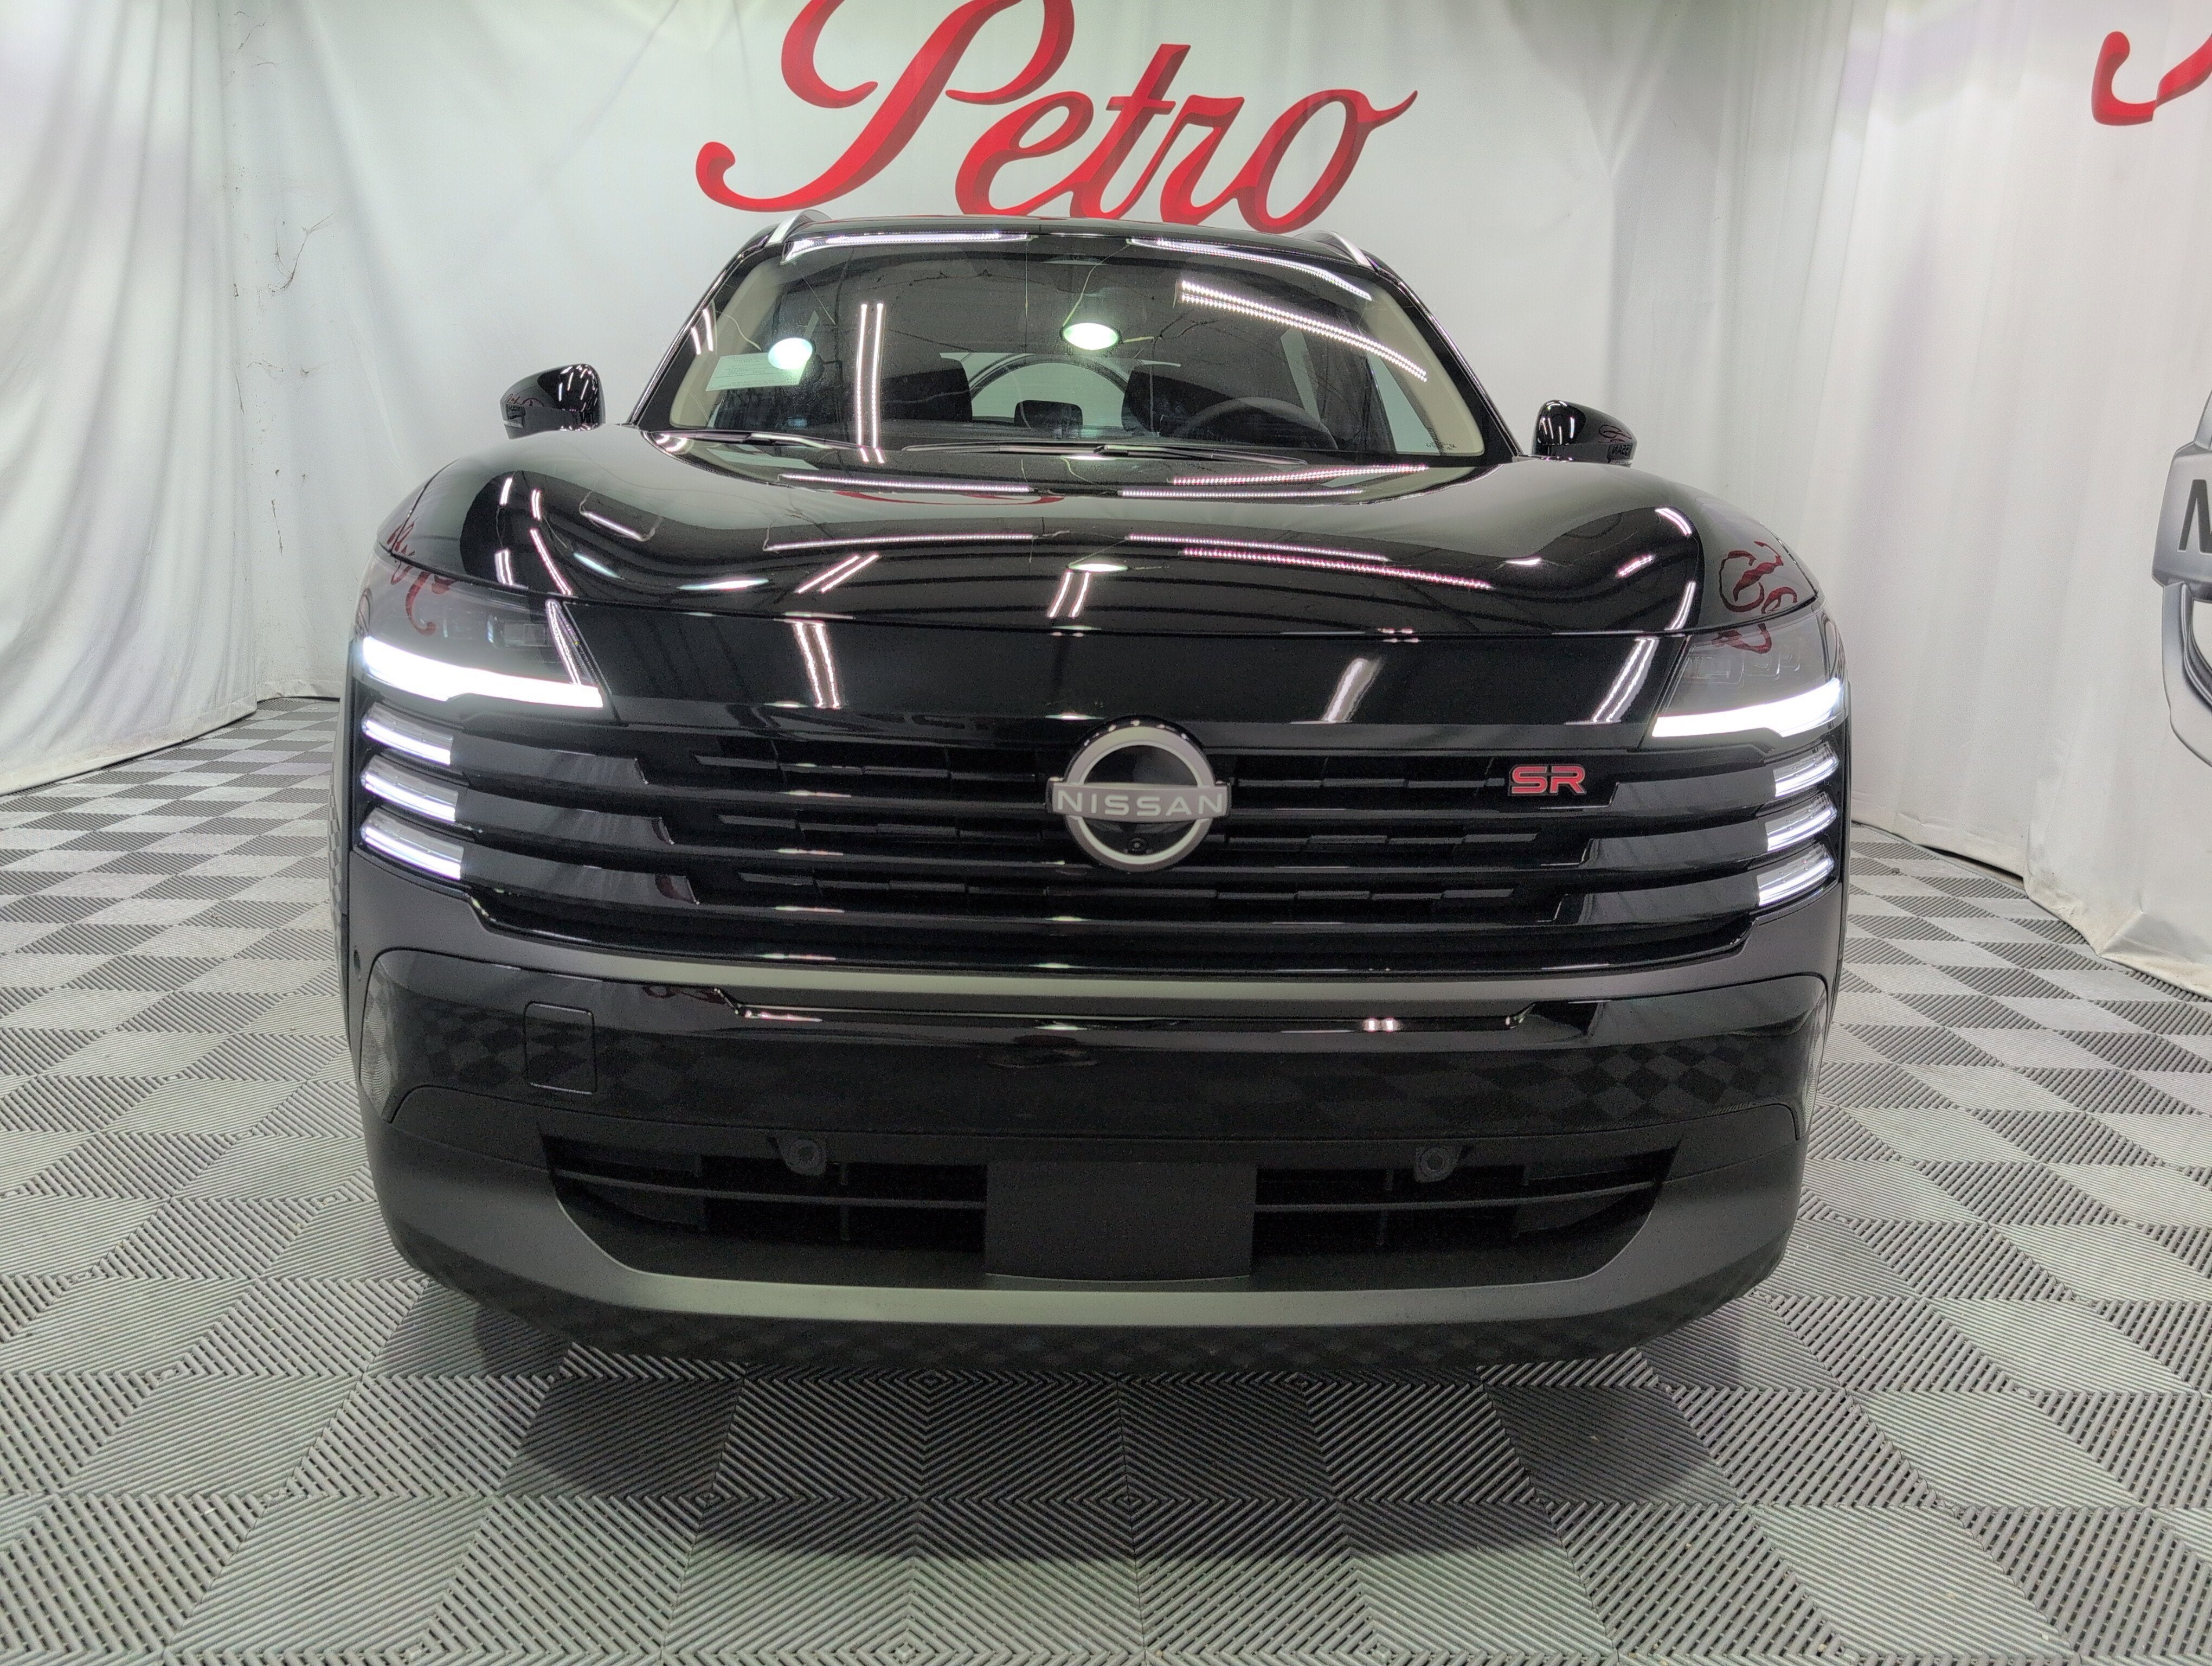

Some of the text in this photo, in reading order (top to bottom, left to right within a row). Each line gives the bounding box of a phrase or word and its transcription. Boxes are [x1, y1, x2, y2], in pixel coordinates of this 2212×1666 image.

[695, 0, 1418, 233] Petro
[1512, 765, 1585, 793] SR
[1057, 789, 1223, 817] NISSAN
